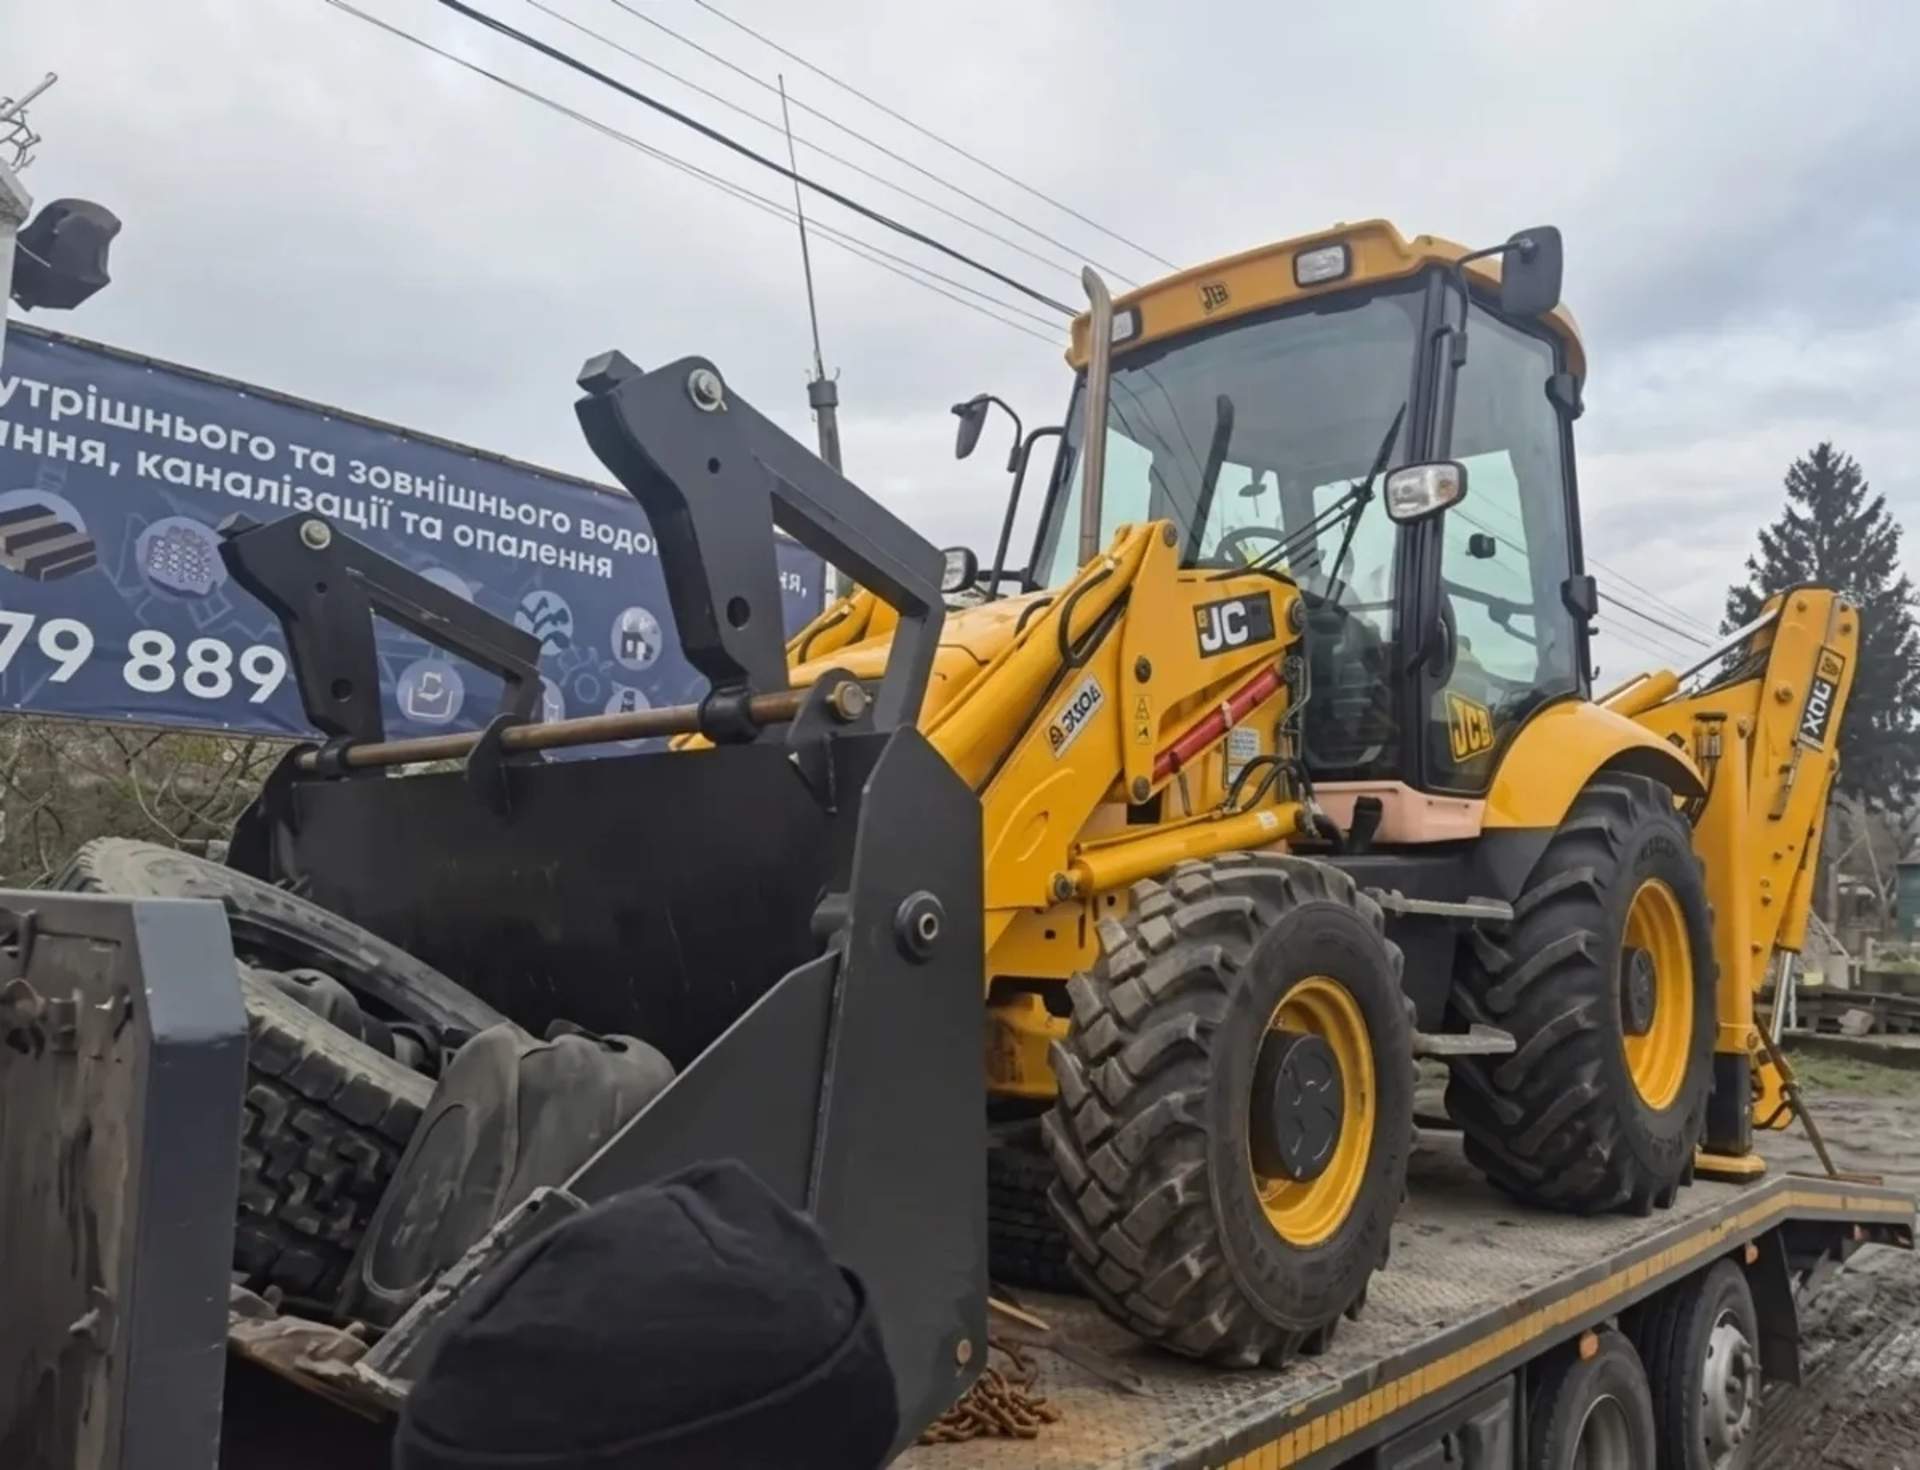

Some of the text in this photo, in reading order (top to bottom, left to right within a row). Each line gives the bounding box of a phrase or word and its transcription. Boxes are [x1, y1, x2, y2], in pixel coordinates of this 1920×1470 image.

[137, 451, 394, 531] каналізації
[401, 512, 443, 541] та
[453, 523, 613, 579] опалення
[289, 444, 336, 477] та
[348, 459, 572, 535] зовнішнього
[580, 518, 657, 556] водо
[123, 629, 287, 704] 889
[1450, 696, 1491, 757] JCB
